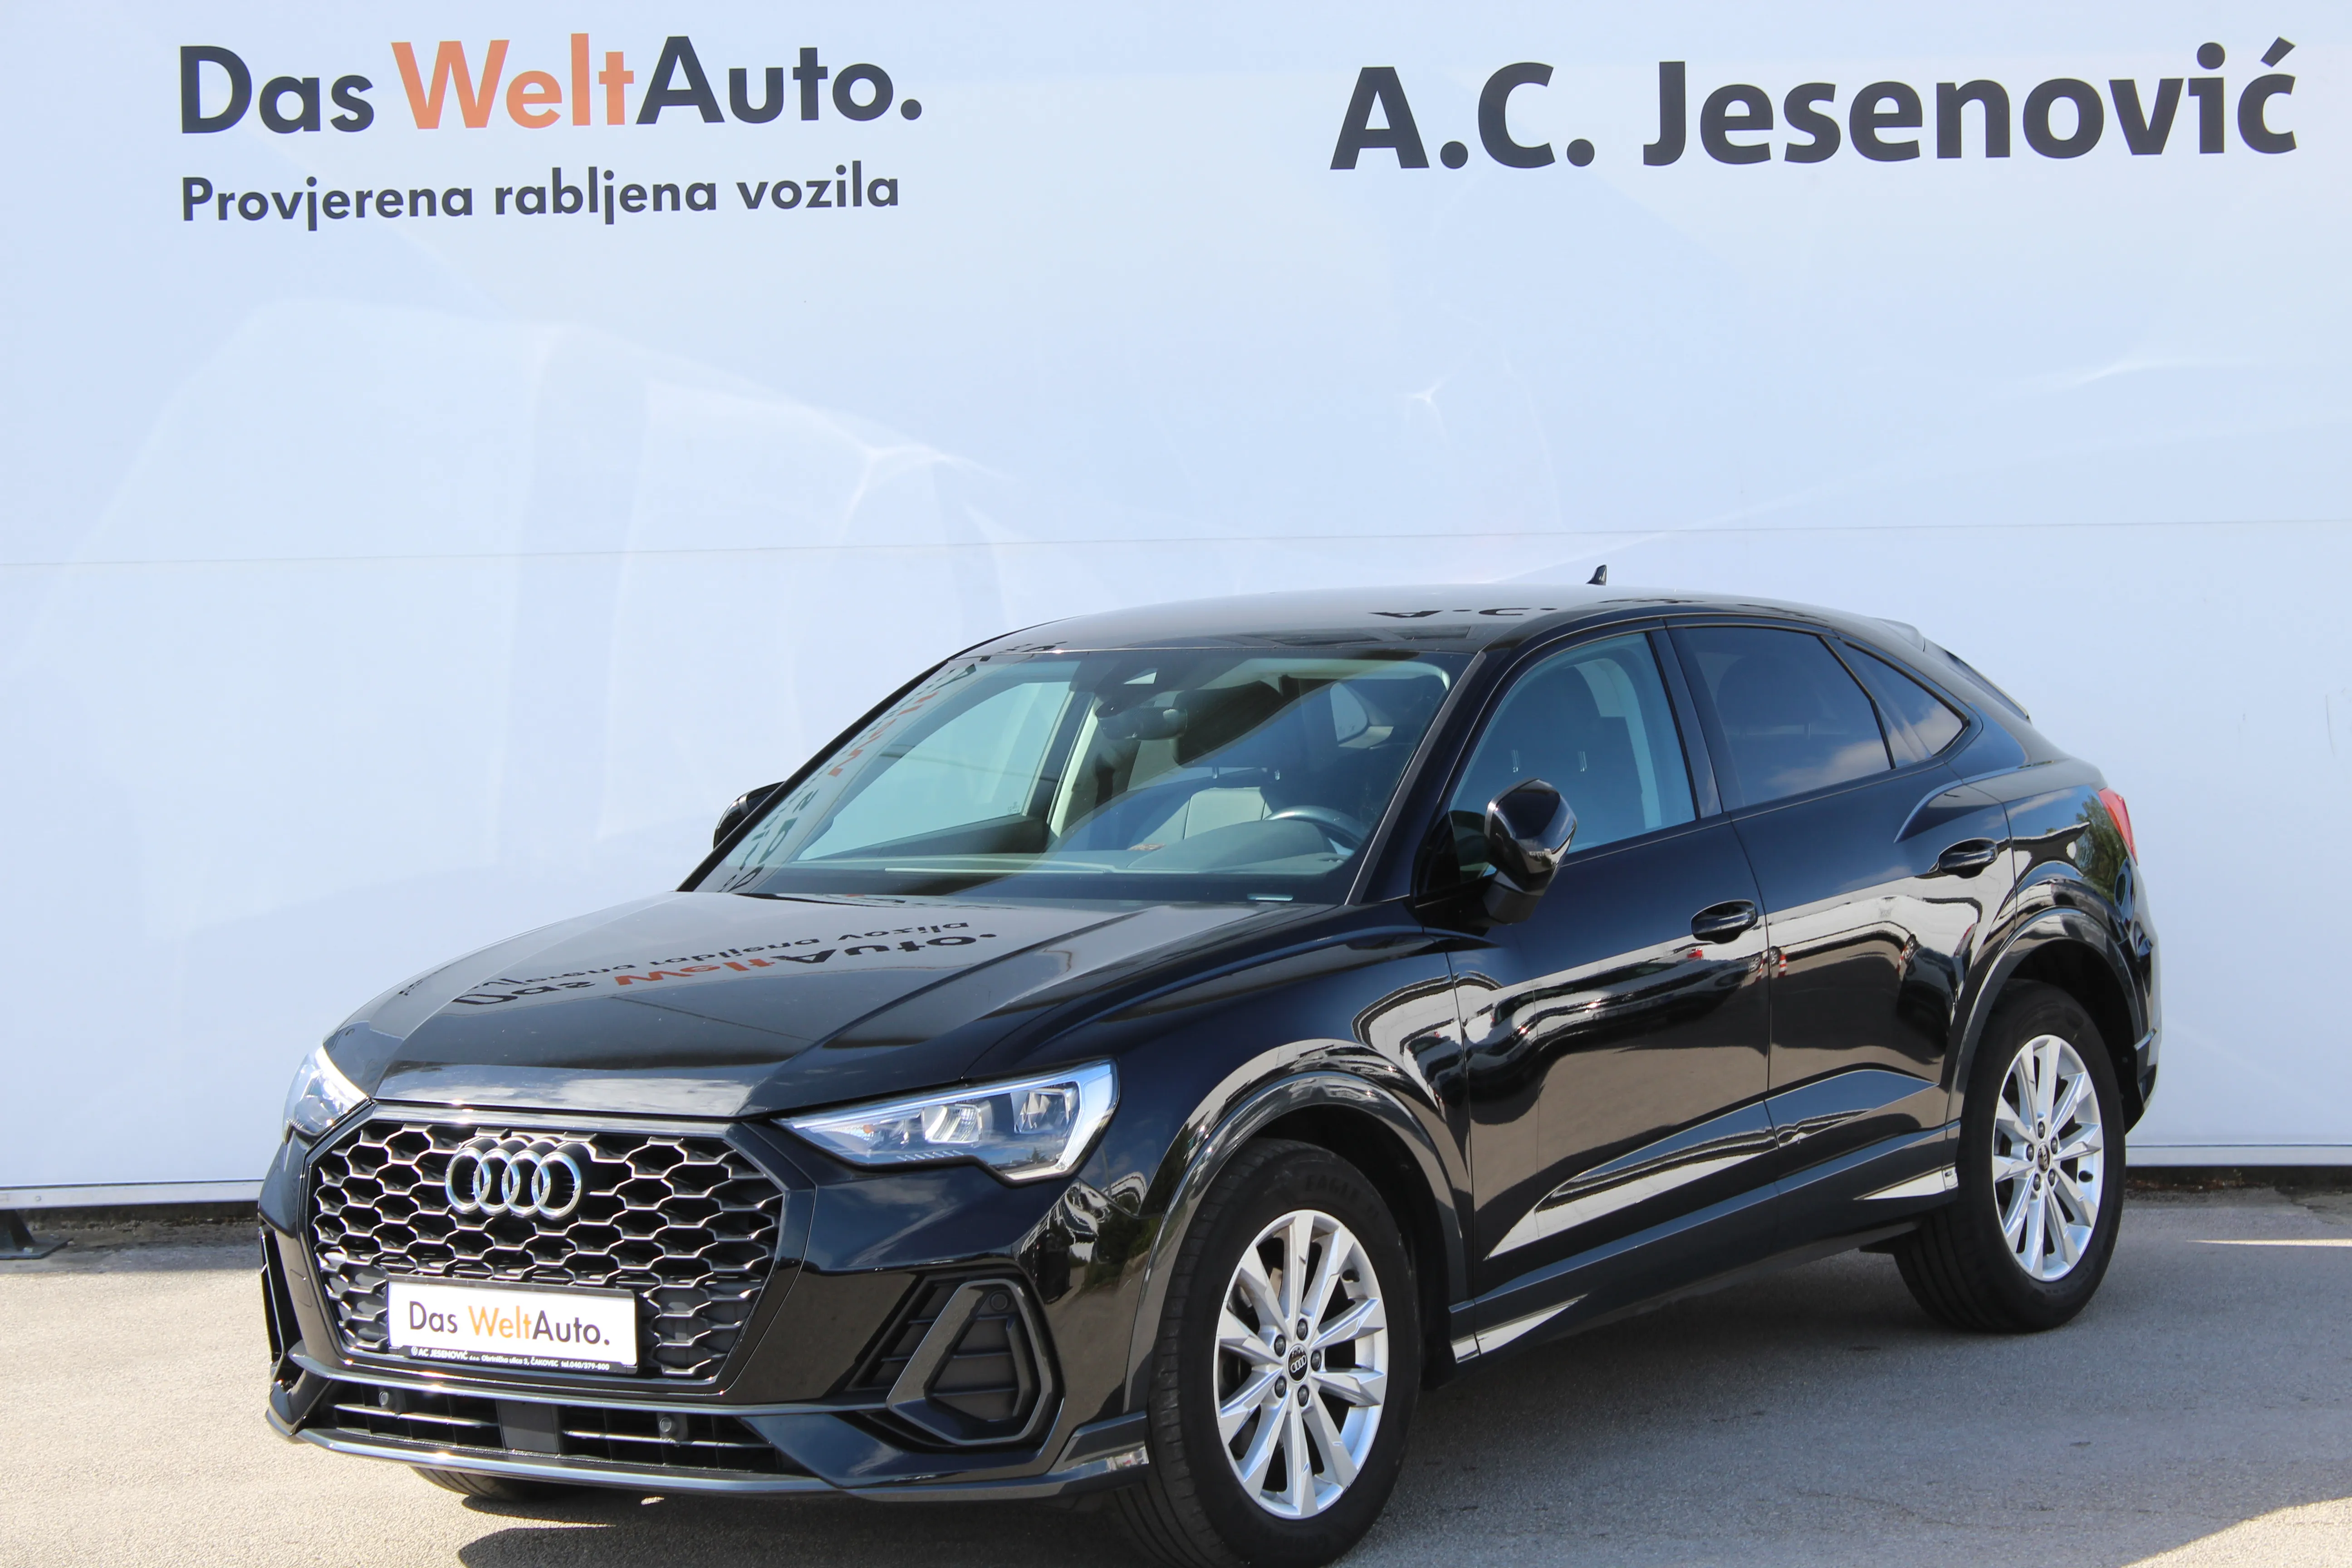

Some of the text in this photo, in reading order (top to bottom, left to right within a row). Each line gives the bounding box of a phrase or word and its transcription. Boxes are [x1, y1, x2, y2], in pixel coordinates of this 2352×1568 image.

[181, 34, 921, 133] Das WeltAuto.
[1330, 38, 2296, 169] A.C. Jesenović
[183, 161, 897, 230] Provjerena rabljena vozila
[410, 1301, 610, 1345] Das WeltAuto.
[418, 1348, 429, 1357] AC
[430, 1349, 468, 1360] JESENOVIĆ
[530, 1356, 559, 1367] ČAKOVEC
